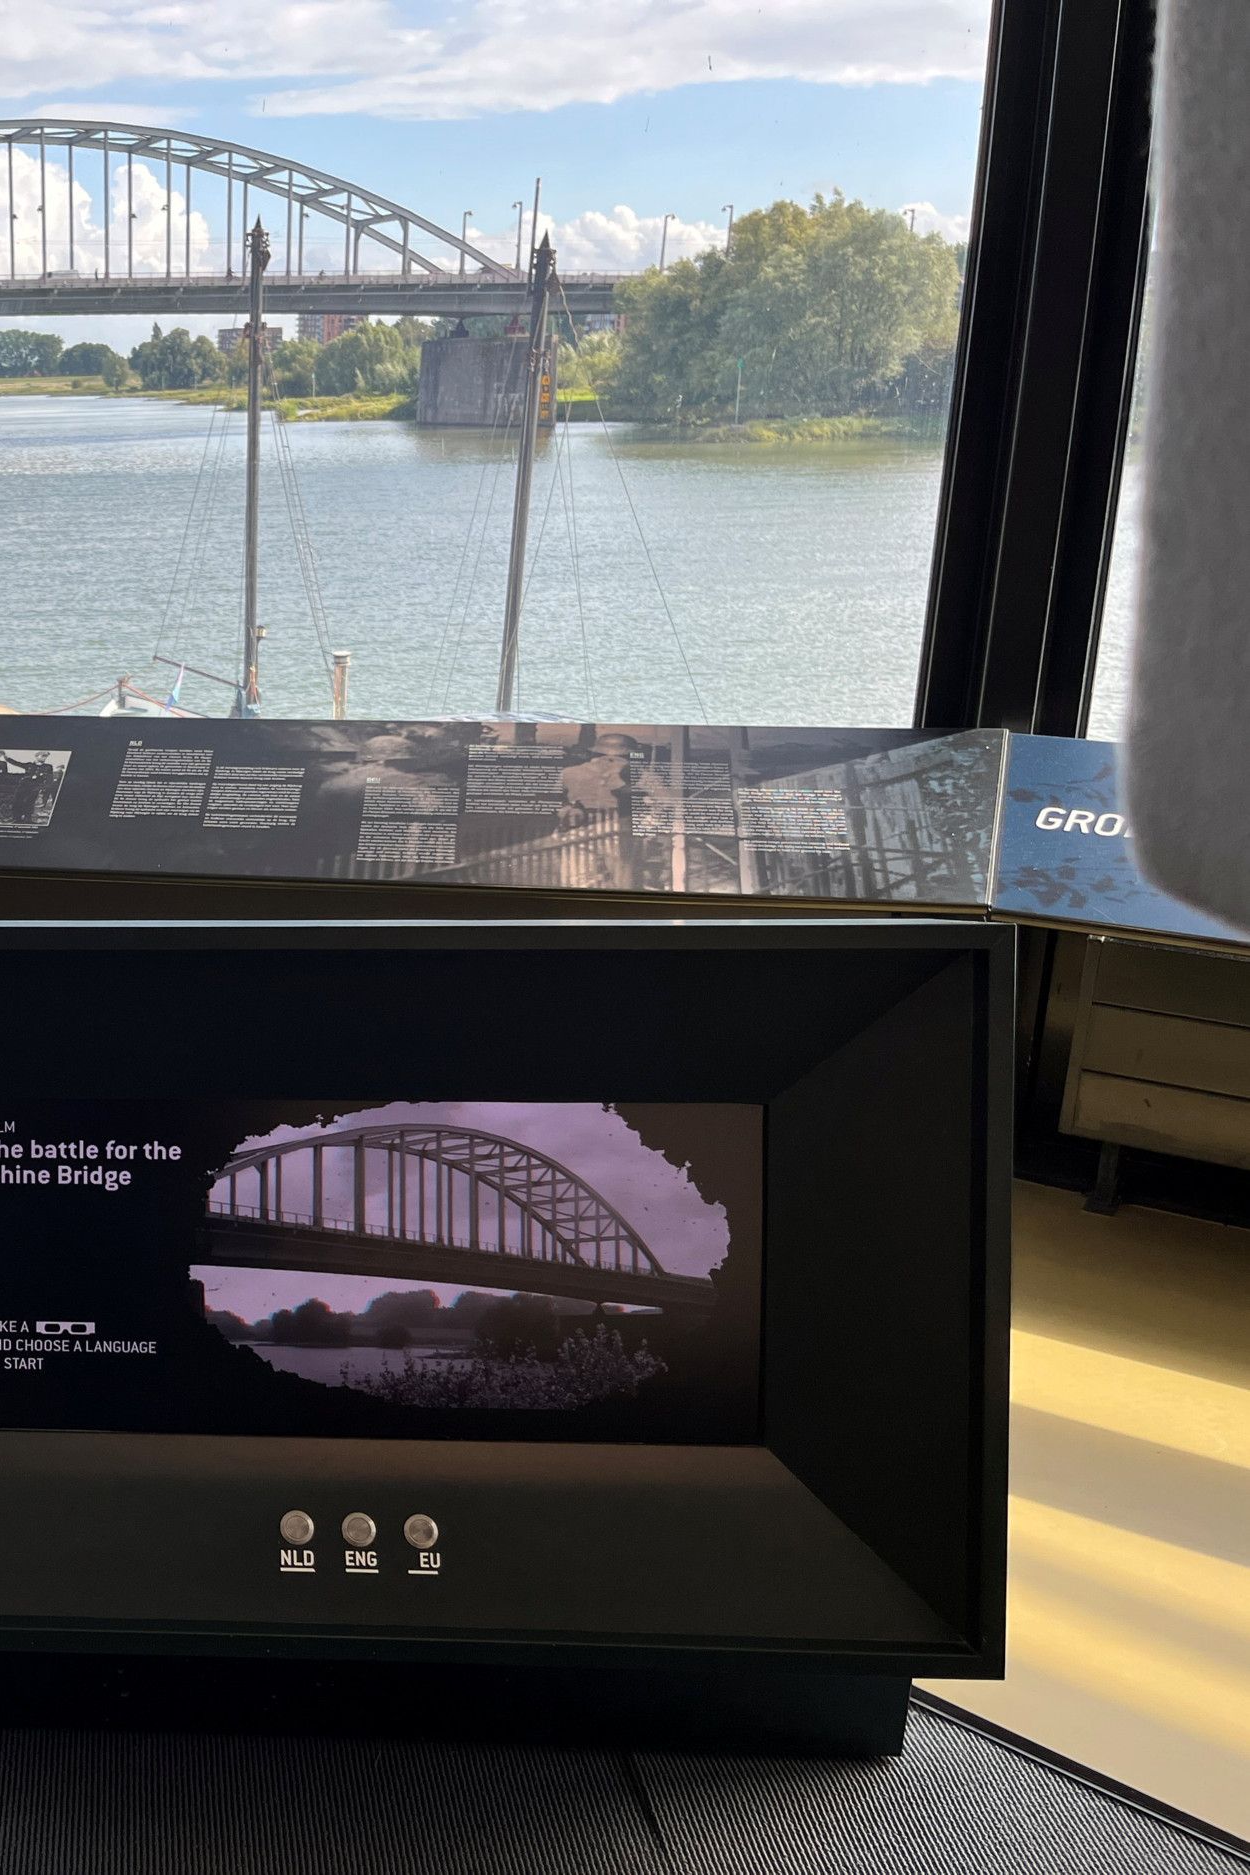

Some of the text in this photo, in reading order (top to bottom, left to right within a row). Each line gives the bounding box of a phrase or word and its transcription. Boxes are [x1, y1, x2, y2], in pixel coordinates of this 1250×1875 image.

[1035, 806, 1134, 838] GRO
[30, 1139, 99, 1160] battle
[105, 1140, 138, 1160] for
[143, 1141, 182, 1161] the
[57, 1165, 132, 1191] Bridge
[20, 1320, 30, 1333] A
[15, 1339, 70, 1352] CHOOSE
[73, 1340, 82, 1353] A
[85, 1341, 157, 1354] LANGUAGE
[4, 1357, 44, 1370] START
[280, 1549, 315, 1567] NLD
[345, 1550, 378, 1568] ENG
[419, 1552, 441, 1569] EU
